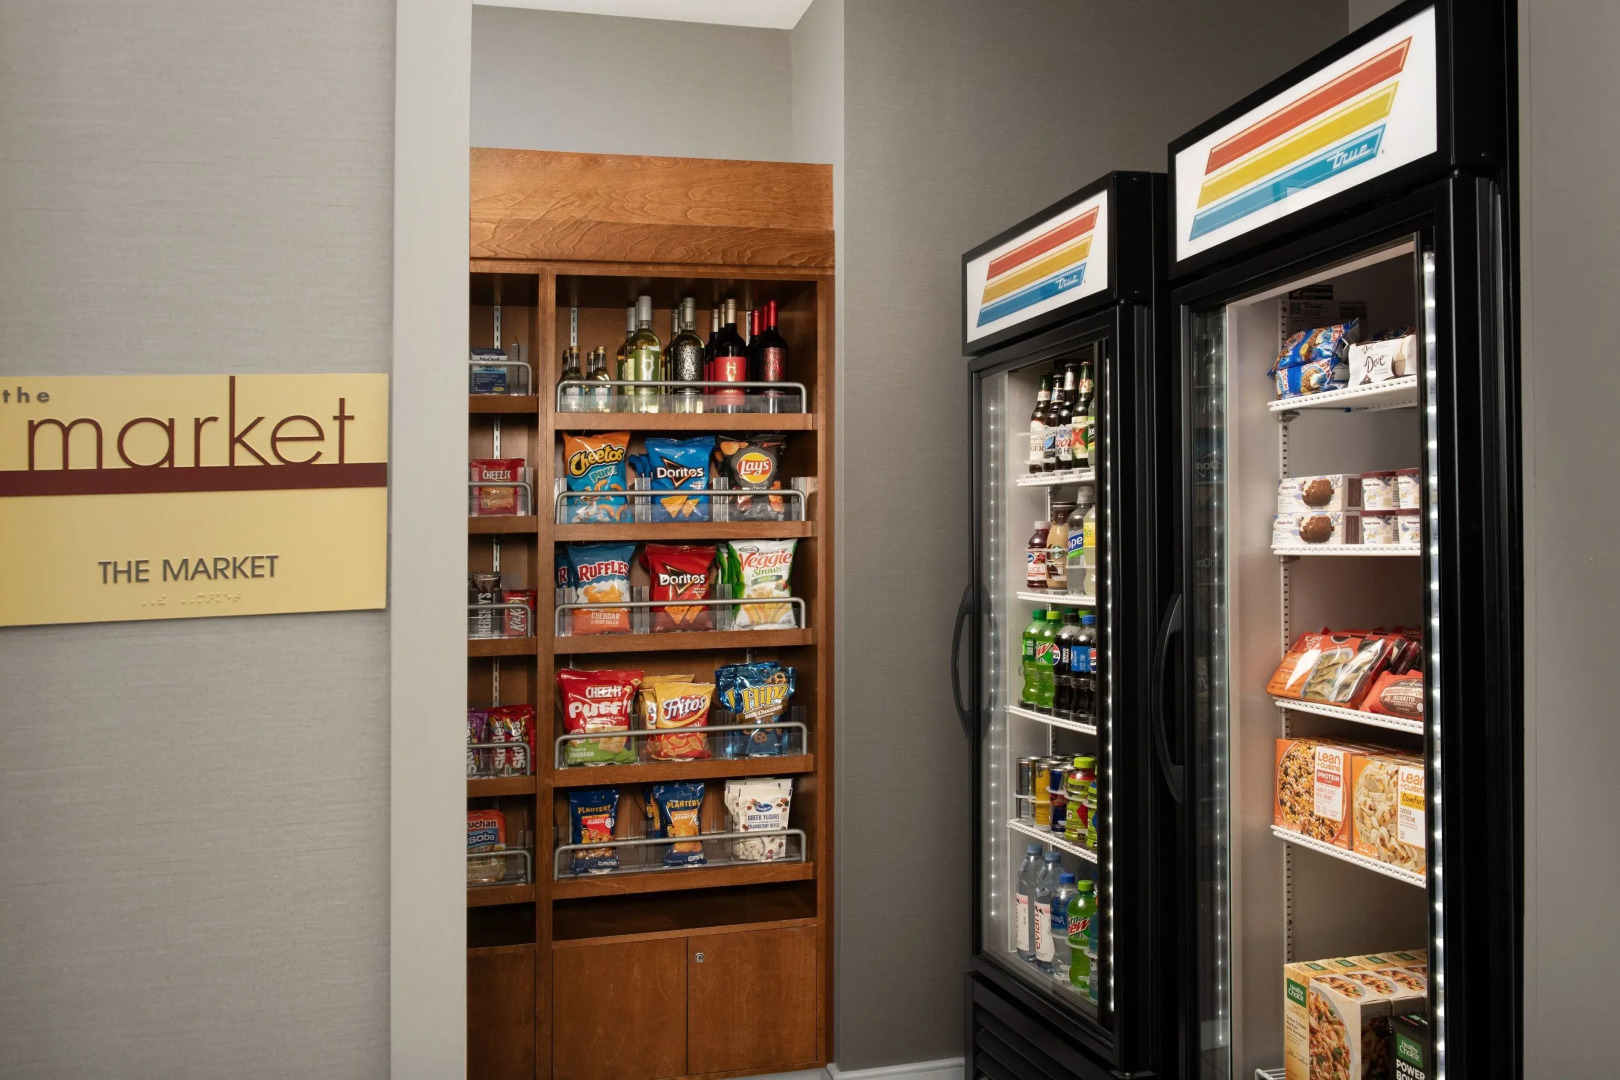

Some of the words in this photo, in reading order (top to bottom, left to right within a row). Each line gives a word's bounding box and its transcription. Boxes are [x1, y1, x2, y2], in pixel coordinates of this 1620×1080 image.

[1363, 355, 1388, 374] Dove
[2, 386, 50, 404] the
[28, 375, 355, 471] market
[569, 445, 625, 476] Cheetos
[656, 467, 704, 479] Doritos
[98, 559, 150, 585] THE
[162, 554, 279, 582] MARKET
[578, 560, 629, 582] RUFFLES
[739, 550, 793, 572] Veggie
[659, 573, 706, 586] Doritos
[662, 695, 706, 720] Fritos
[741, 684, 788, 714] Flipz
[1317, 751, 1340, 766] Lean
[667, 800, 700, 809] PLANTERS
[1396, 1058, 1426, 1080] POWER
